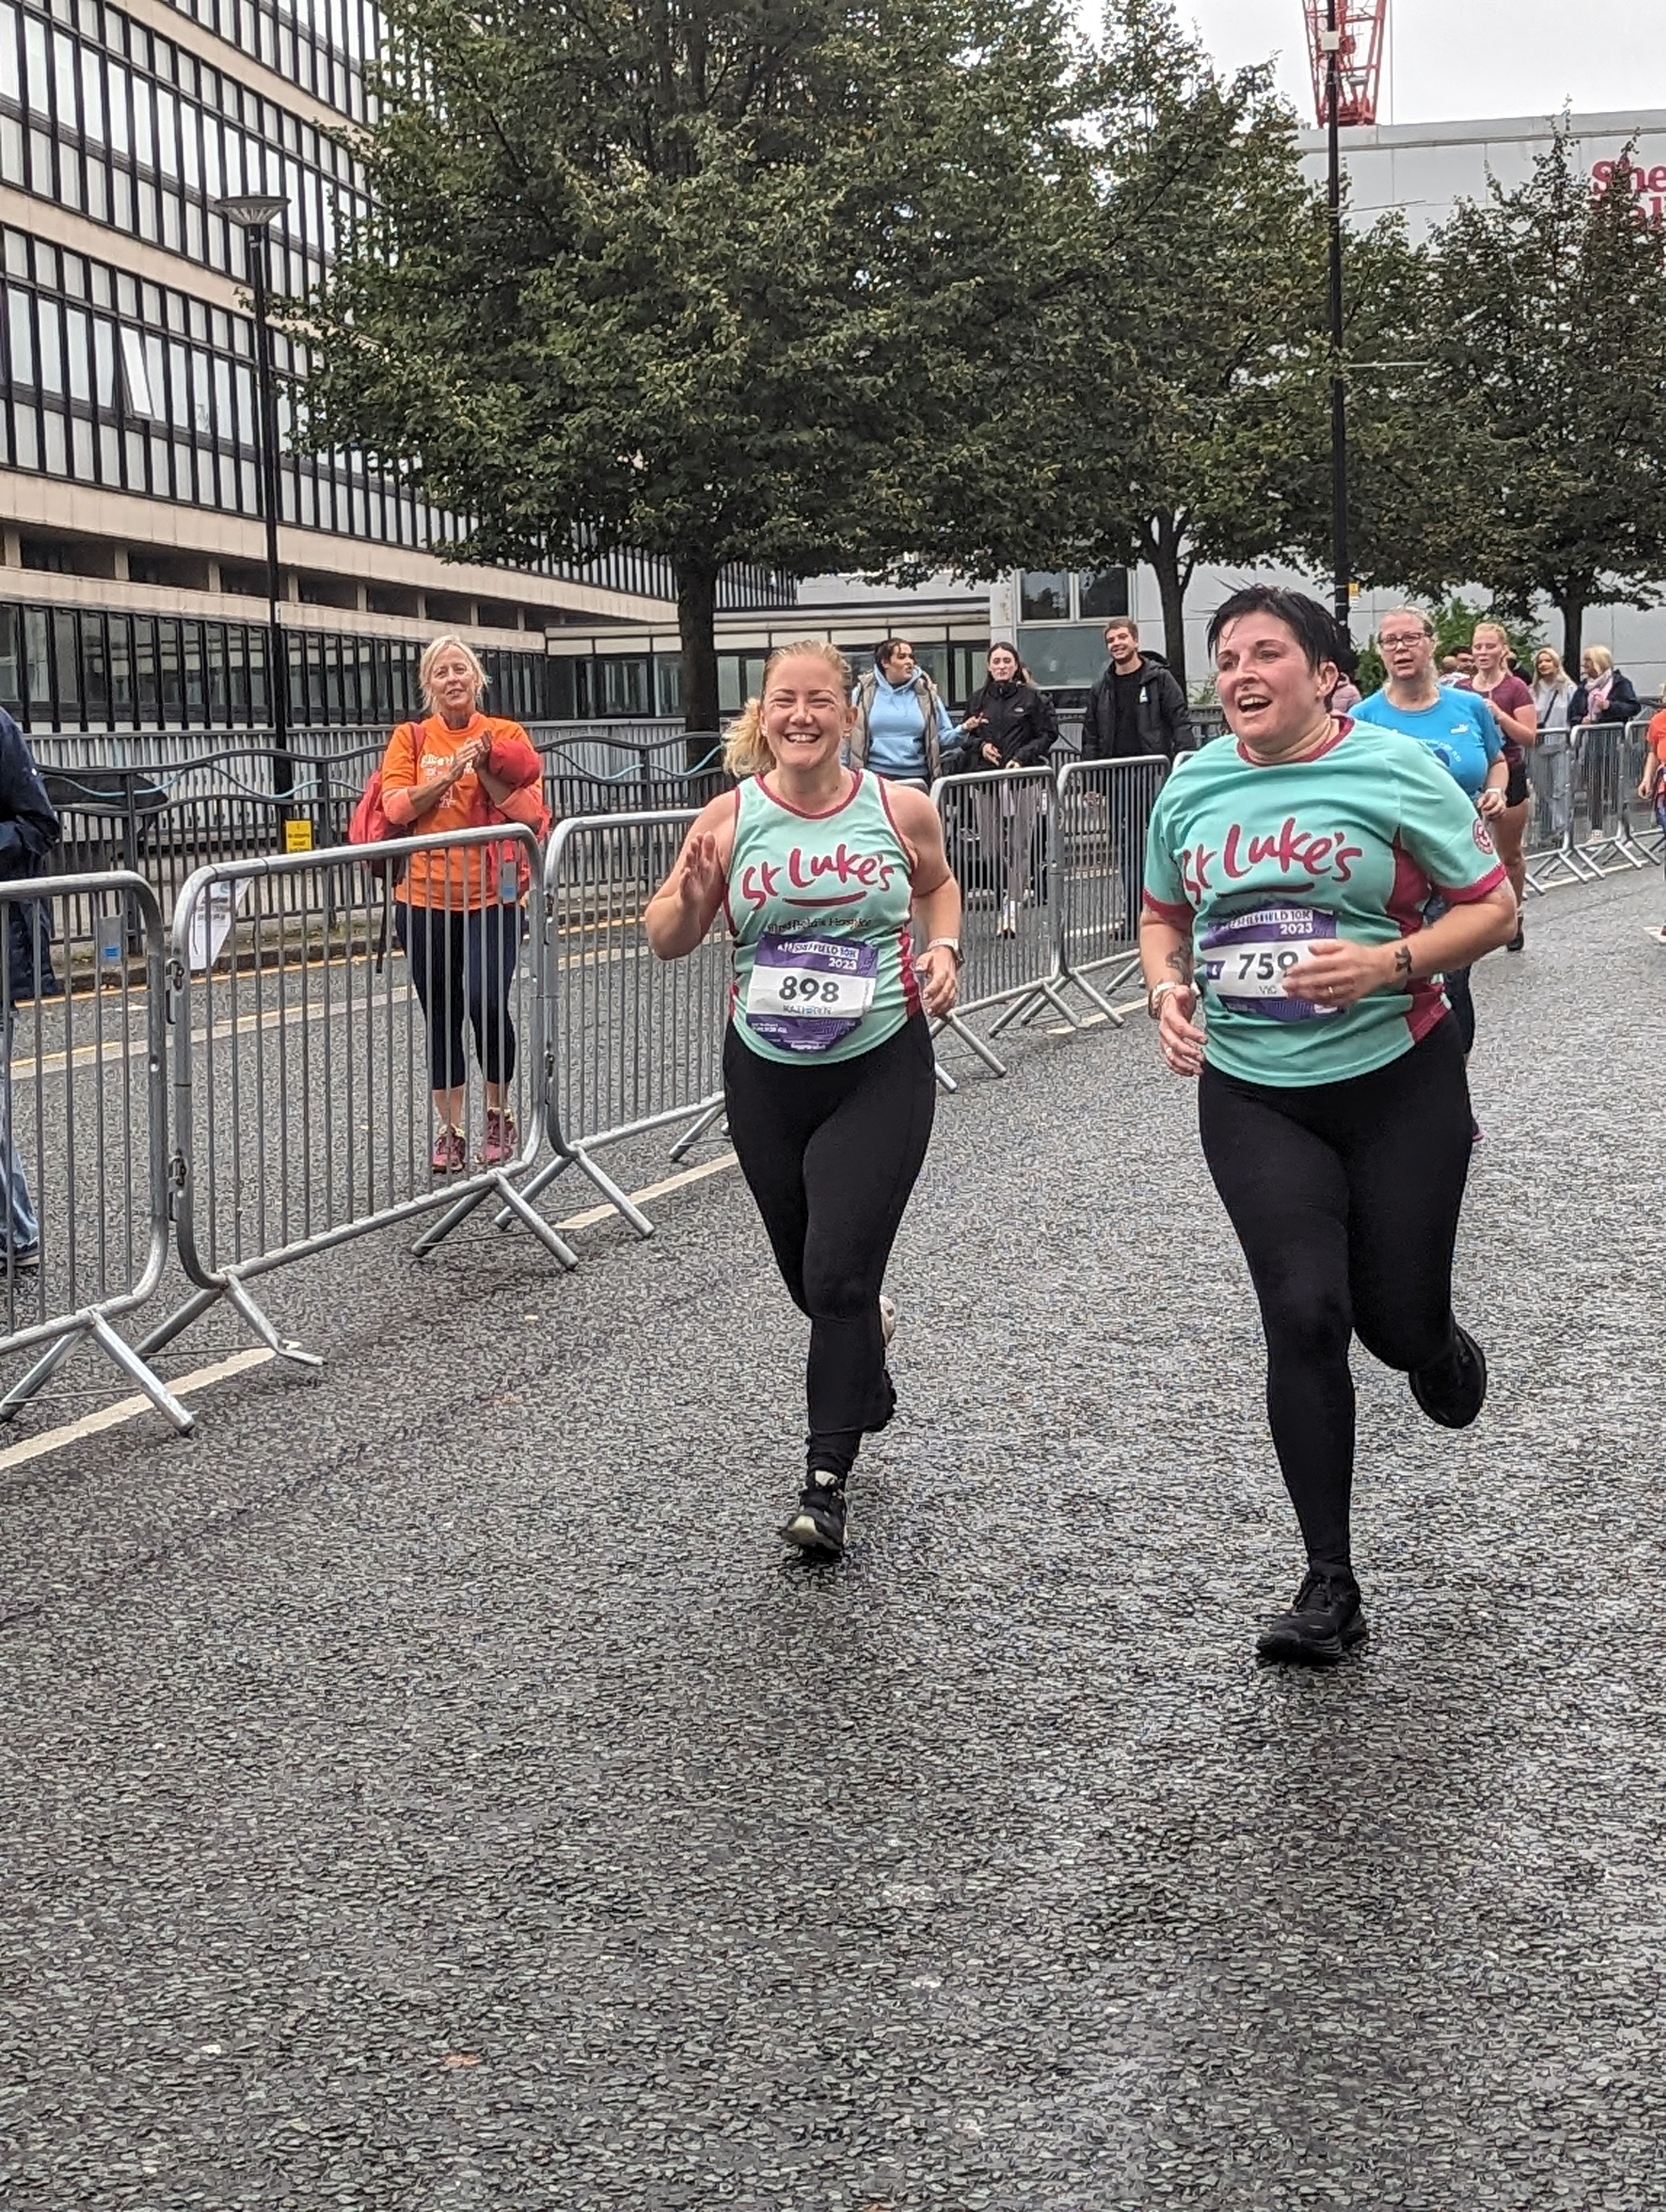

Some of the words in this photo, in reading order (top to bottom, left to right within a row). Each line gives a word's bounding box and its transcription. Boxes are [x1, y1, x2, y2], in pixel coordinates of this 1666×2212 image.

[1183, 844, 1218, 906] St
[1223, 816, 1363, 884] Luke's
[742, 861, 784, 911] St
[789, 843, 895, 891] Luke's
[1279, 923, 1313, 935] 2023
[828, 957, 857, 970] 2023
[778, 975, 840, 1003] 898
